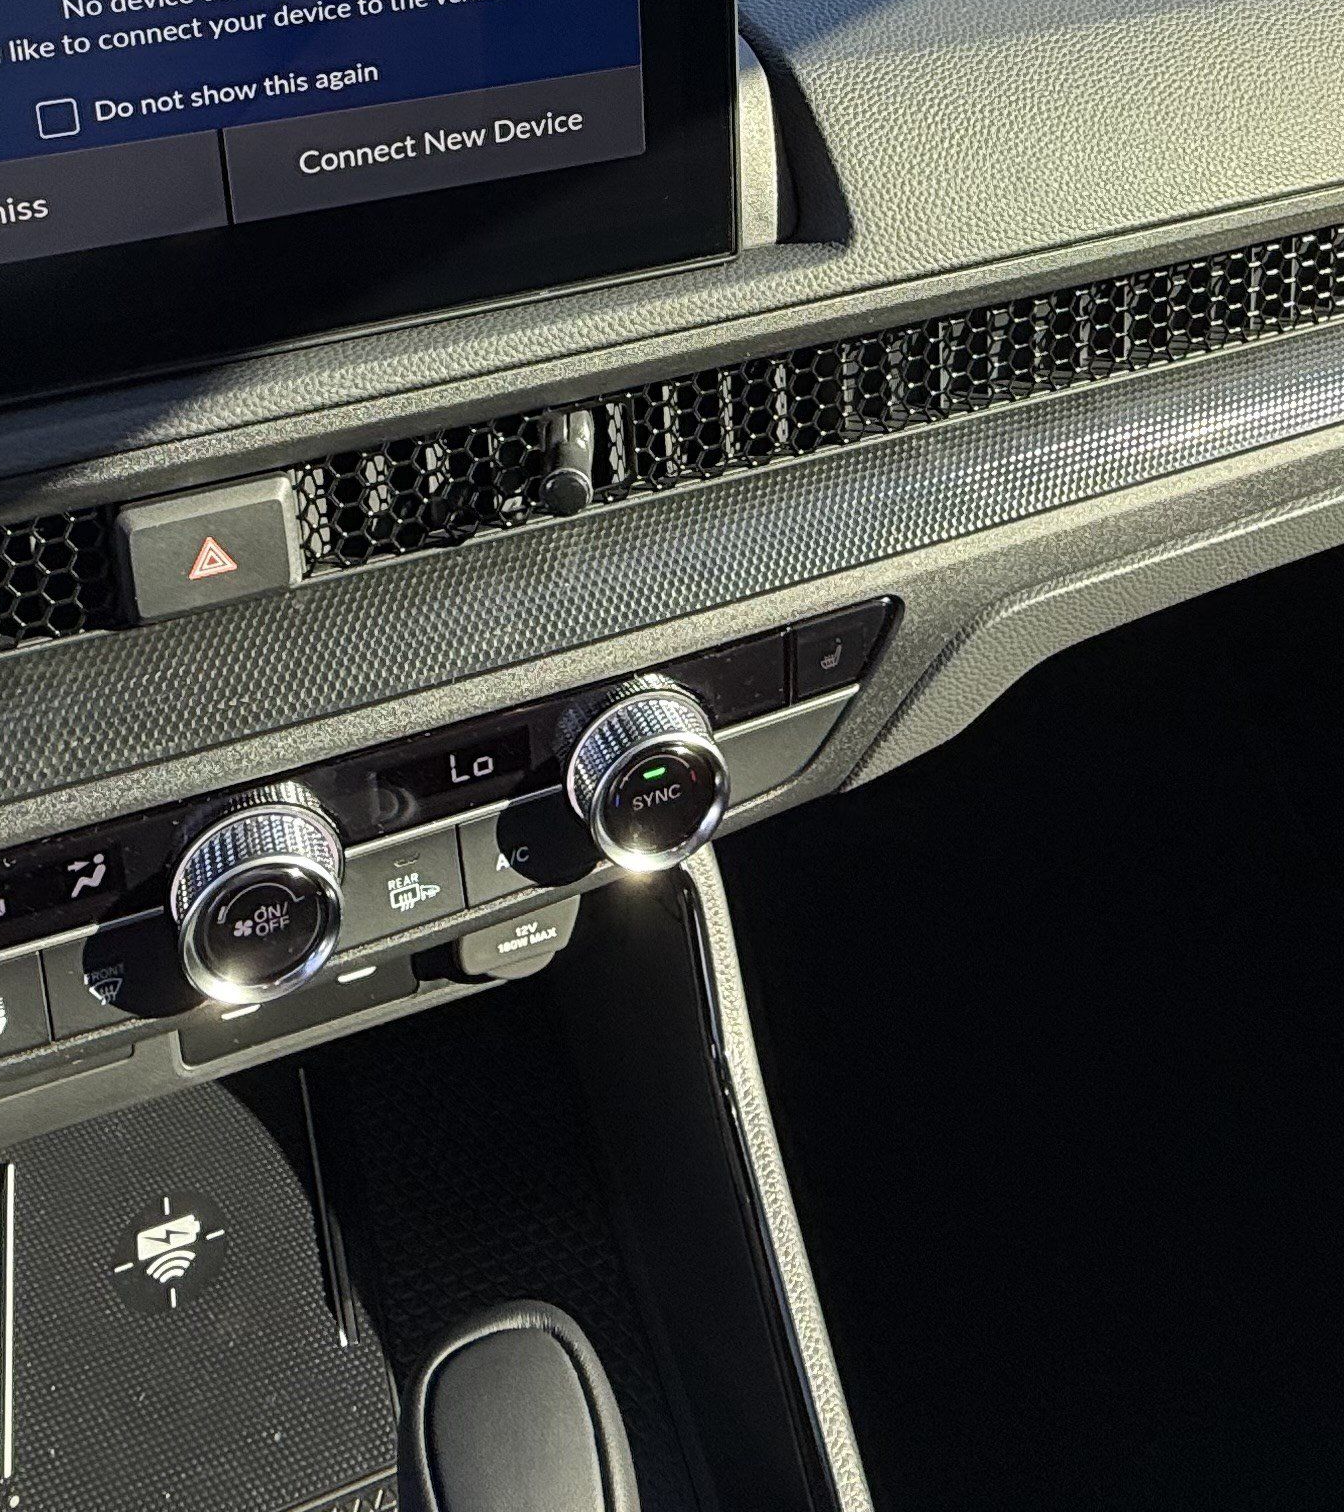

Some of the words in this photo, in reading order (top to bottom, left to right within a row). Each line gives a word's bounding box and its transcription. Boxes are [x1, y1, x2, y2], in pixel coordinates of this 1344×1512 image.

[8, 39, 55, 62] like
[61, 35, 91, 55] to
[98, 18, 202, 49] connect
[208, 11, 267, 39] your
[273, 1, 352, 27] device
[95, 99, 134, 122] Do
[141, 91, 184, 115] not
[191, 85, 257, 108] show
[263, 73, 309, 96] this
[315, 63, 379, 90] again
[299, 137, 417, 174] Connect
[423, 127, 486, 155] New
[493, 111, 583, 143] Device
[450, 754, 494, 783] Lo
[631, 784, 682, 811] SYNC
[496, 846, 529, 872] A/C
[388, 872, 419, 890] REAR
[254, 901, 289, 923] ON/
[256, 918, 291, 937] OFF
[497, 936, 528, 954] 180W
[530, 927, 557, 944] MAX
[516, 922, 538, 937] 12V
